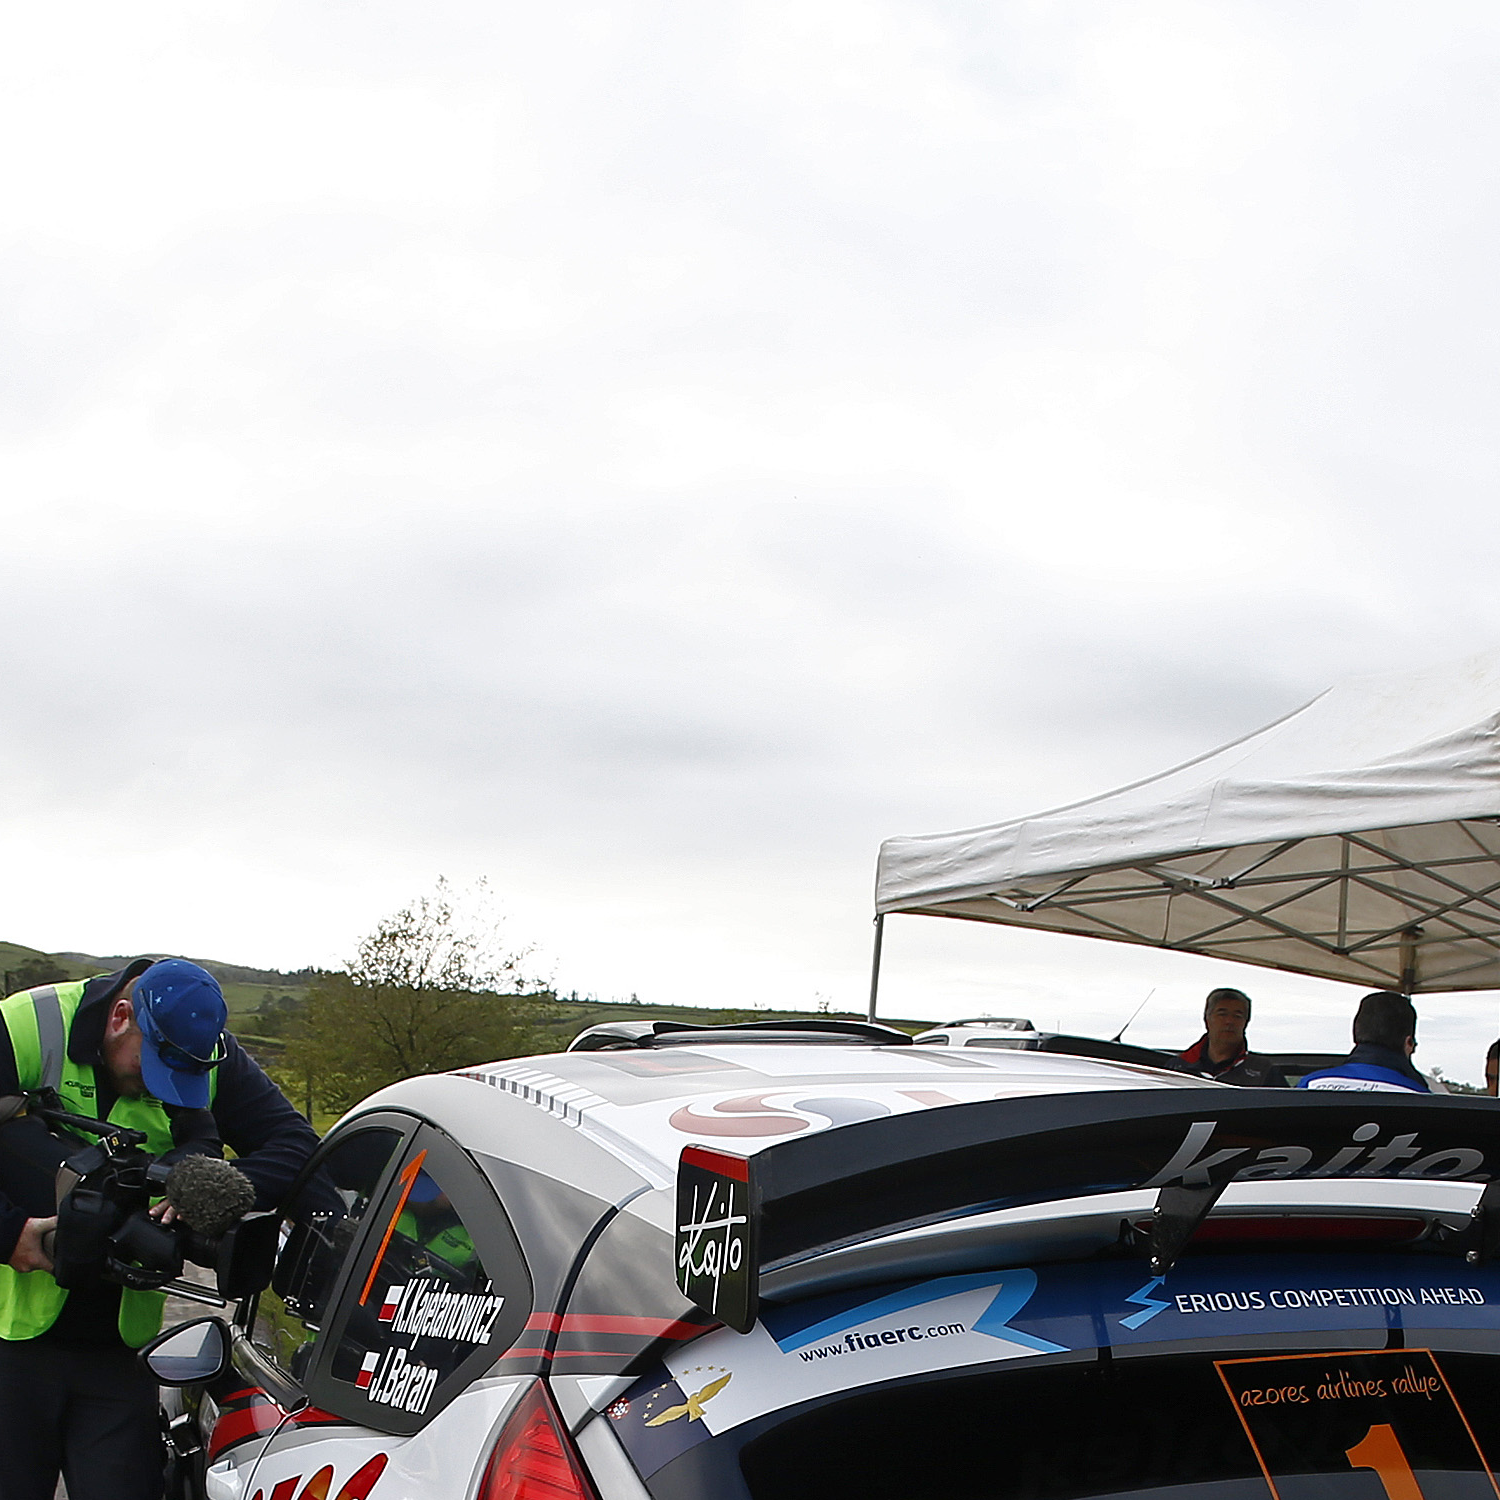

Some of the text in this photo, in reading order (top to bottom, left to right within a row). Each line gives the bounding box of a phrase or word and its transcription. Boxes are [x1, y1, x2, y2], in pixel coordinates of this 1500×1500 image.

[1268, 1285, 1416, 1311] COMPETITION
[1419, 1286, 1486, 1306] AHEAD
[799, 1320, 966, 1362] www.fiaerc.com
[367, 1346, 439, 1415] J.Baran
[1240, 1365, 1441, 1407] azores airlines rallye
